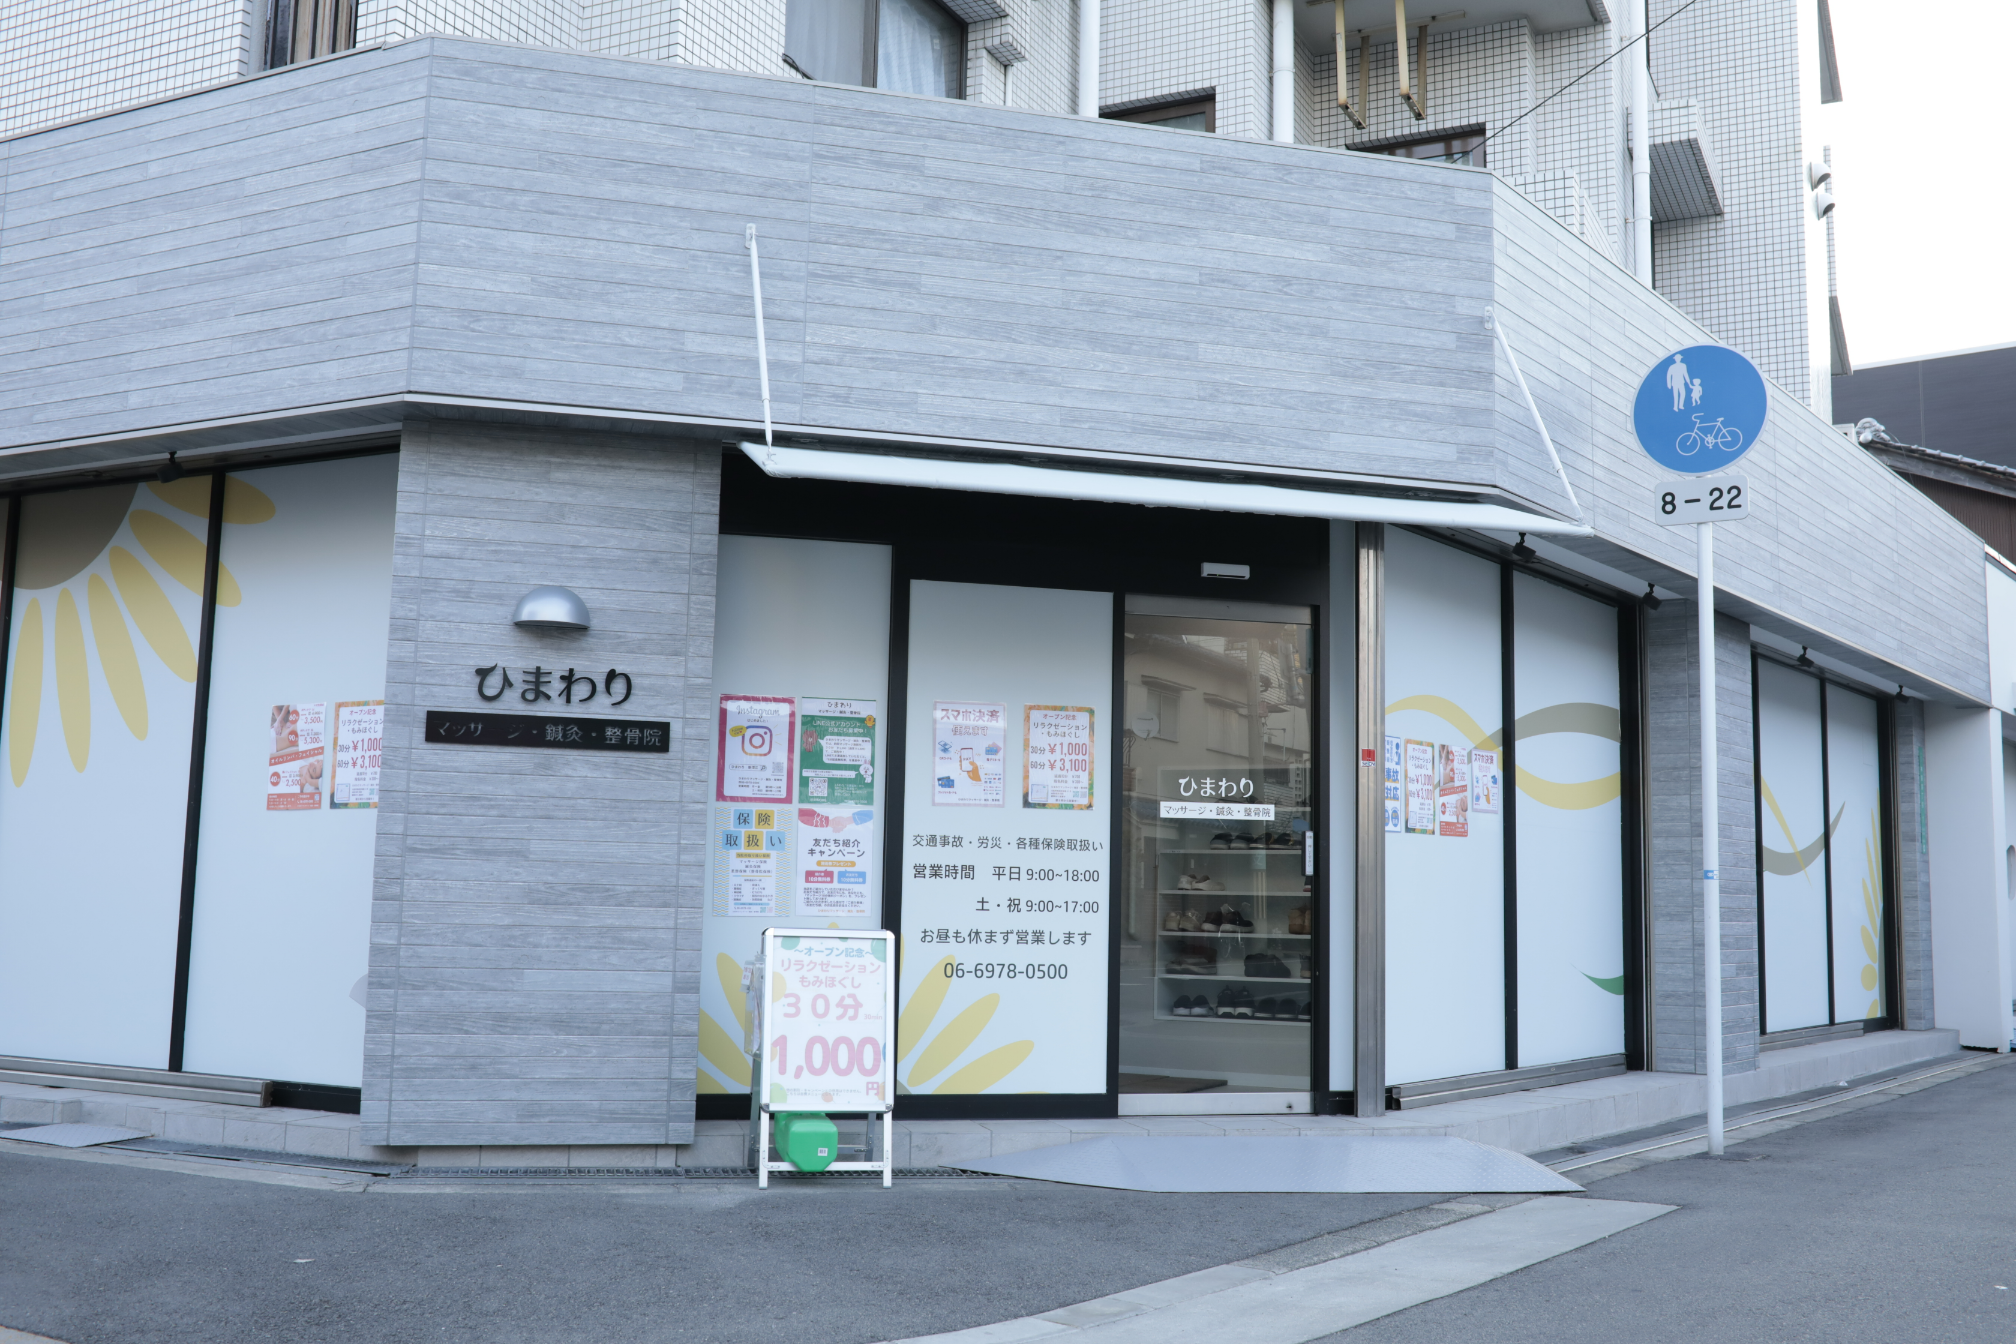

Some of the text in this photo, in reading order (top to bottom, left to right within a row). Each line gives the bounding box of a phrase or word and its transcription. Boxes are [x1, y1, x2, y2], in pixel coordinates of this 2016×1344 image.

[475, 662, 633, 706] ひまわり
[827, 701, 852, 709] ひまわり
[940, 708, 1000, 724] スマホ決済
[1042, 713, 1078, 721] オープン記念
[1033, 721, 1088, 731] リラクゼーション
[1030, 745, 1046, 755] 30分
[1030, 760, 1046, 770] 60分
[1178, 776, 1254, 798] ひまわり
[1163, 805, 1272, 818] マッサージ・鍼灸・整骨院
[737, 812, 771, 827] 保険
[725, 833, 782, 848] 取扱い
[812, 838, 861, 848] 友だち紹介
[912, 833, 1104, 852] 交通事故・労災・各種保険取扱い
[807, 847, 866, 858] キャンペーン
[913, 863, 975, 880] 営業時間
[992, 865, 1022, 881] 平日
[975, 896, 1022, 913] 土・祝
[920, 928, 1092, 946] お昼も休まず営業します
[781, 959, 881, 974] リラクゼーション
[944, 962, 1069, 980] 06-6978-0500
[799, 975, 862, 989] もみほぐし
[772, 1034, 882, 1096] 1,000 円
